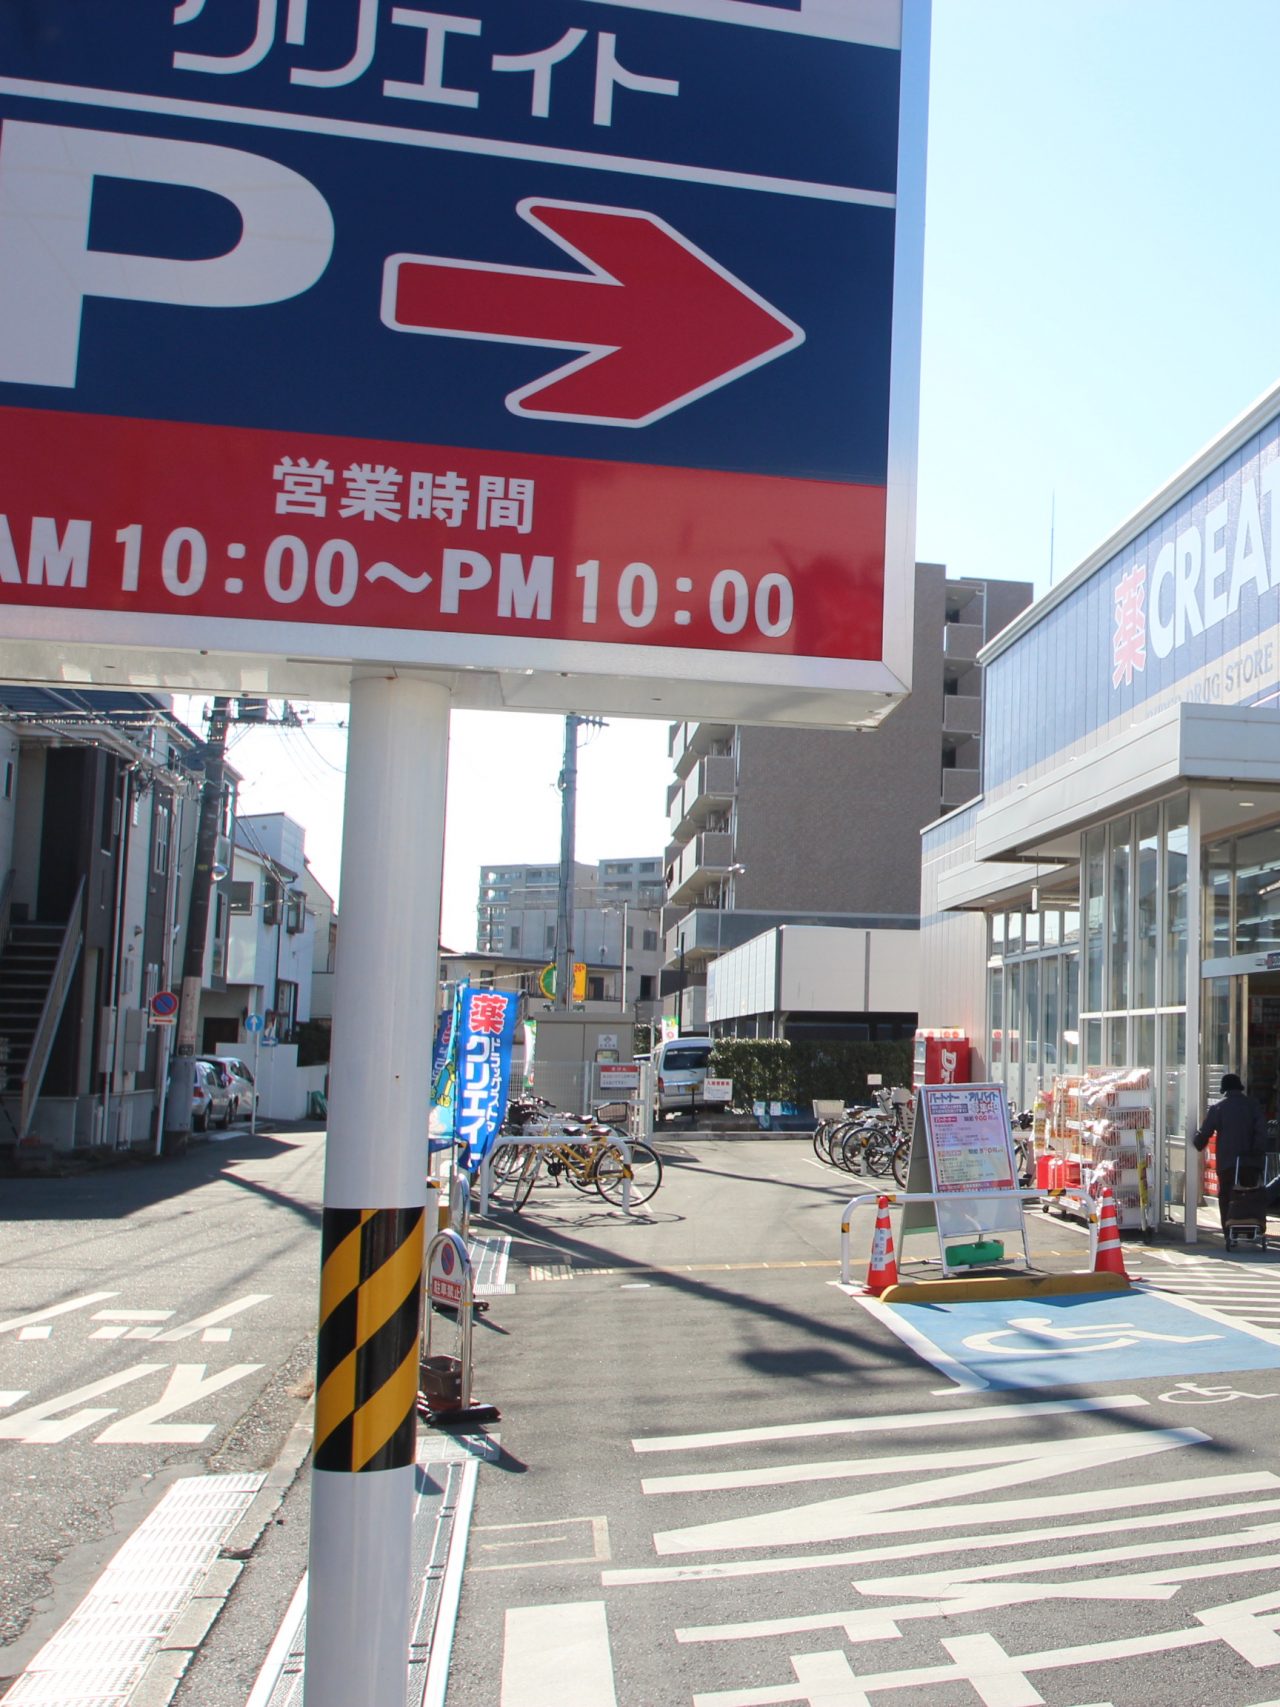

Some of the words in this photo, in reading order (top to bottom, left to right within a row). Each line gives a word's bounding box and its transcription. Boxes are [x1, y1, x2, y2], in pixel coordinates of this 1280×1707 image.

[172, 0, 680, 127] クリエイト
[0, 120, 335, 388] P
[272, 456, 535, 535] 営業時間
[1112, 564, 1146, 690] 薬
[1225, 642, 1273, 693] STORE
[470, 993, 508, 1035] 薬
